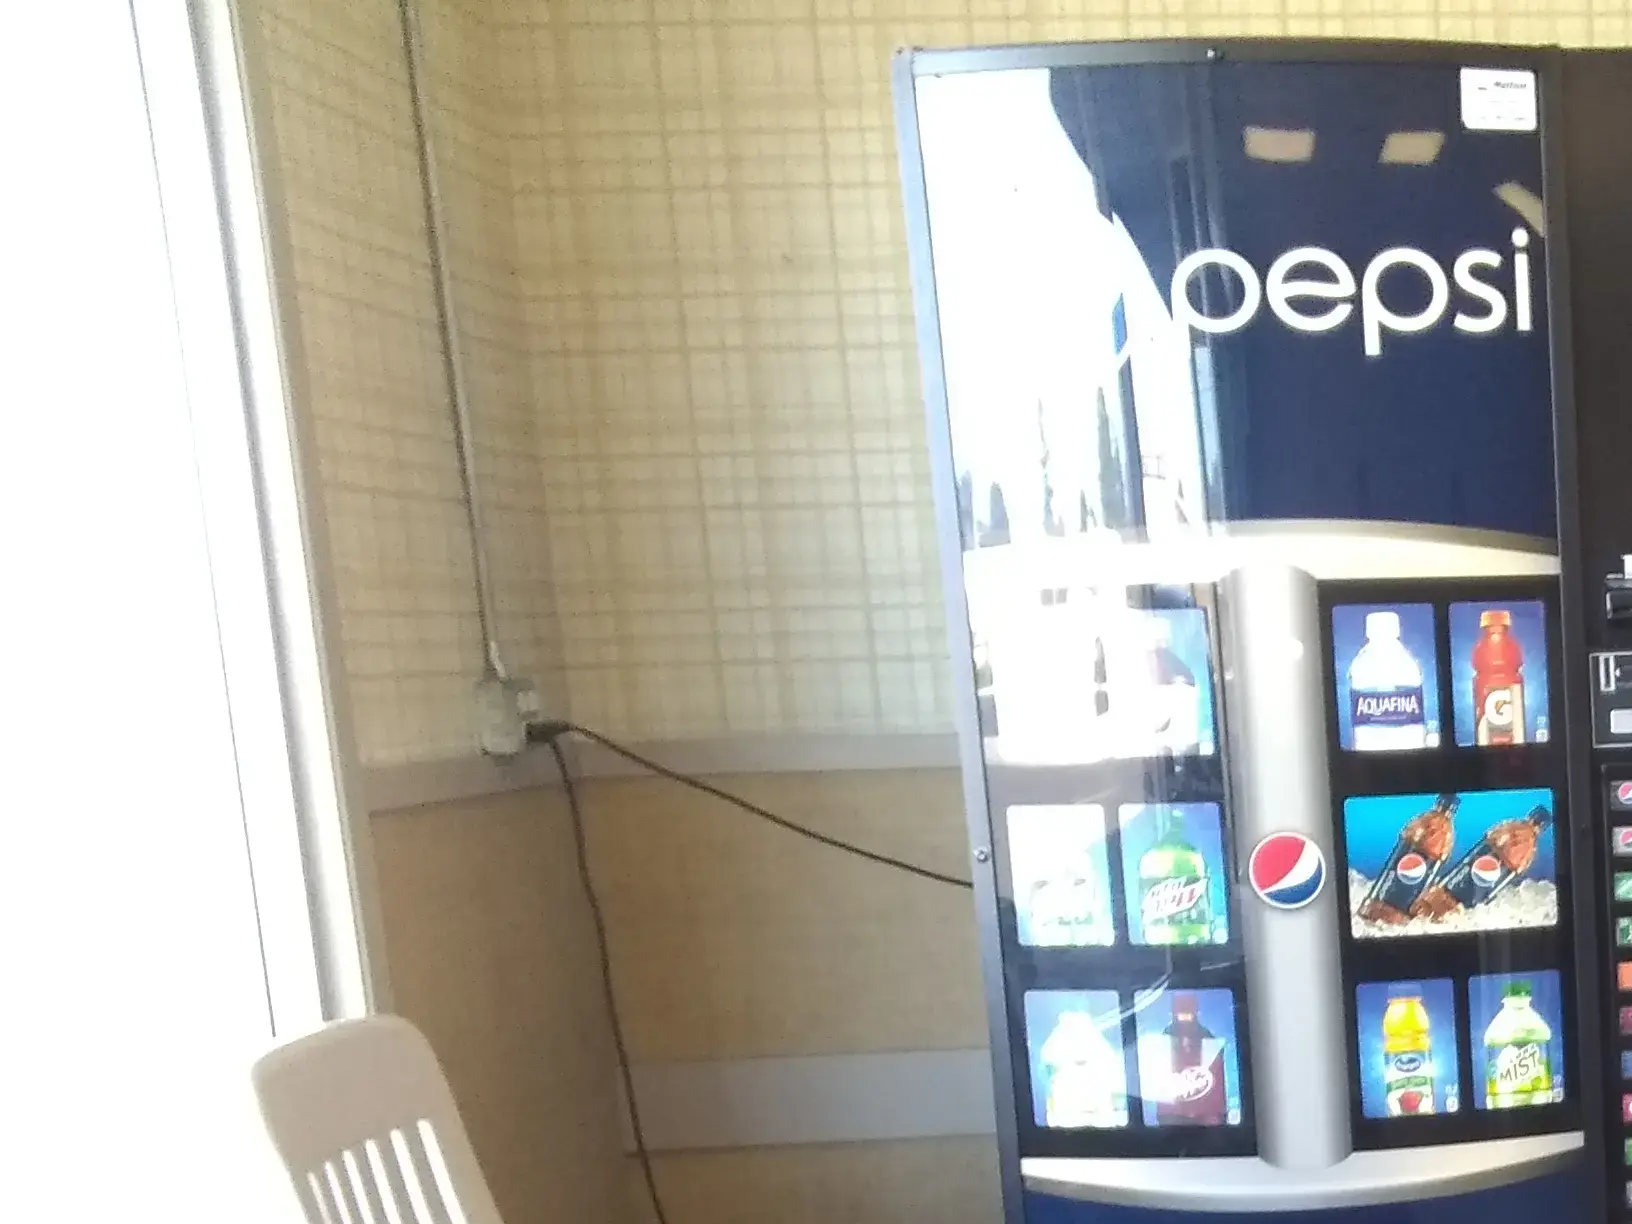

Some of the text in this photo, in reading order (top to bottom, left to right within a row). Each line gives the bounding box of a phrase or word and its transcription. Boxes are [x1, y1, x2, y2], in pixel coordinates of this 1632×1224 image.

[1171, 226, 1535, 357] pepsi
[1356, 693, 1420, 716] AQUAFINA
[1484, 689, 1514, 726] G
[1500, 1050, 1540, 1084] MIST
